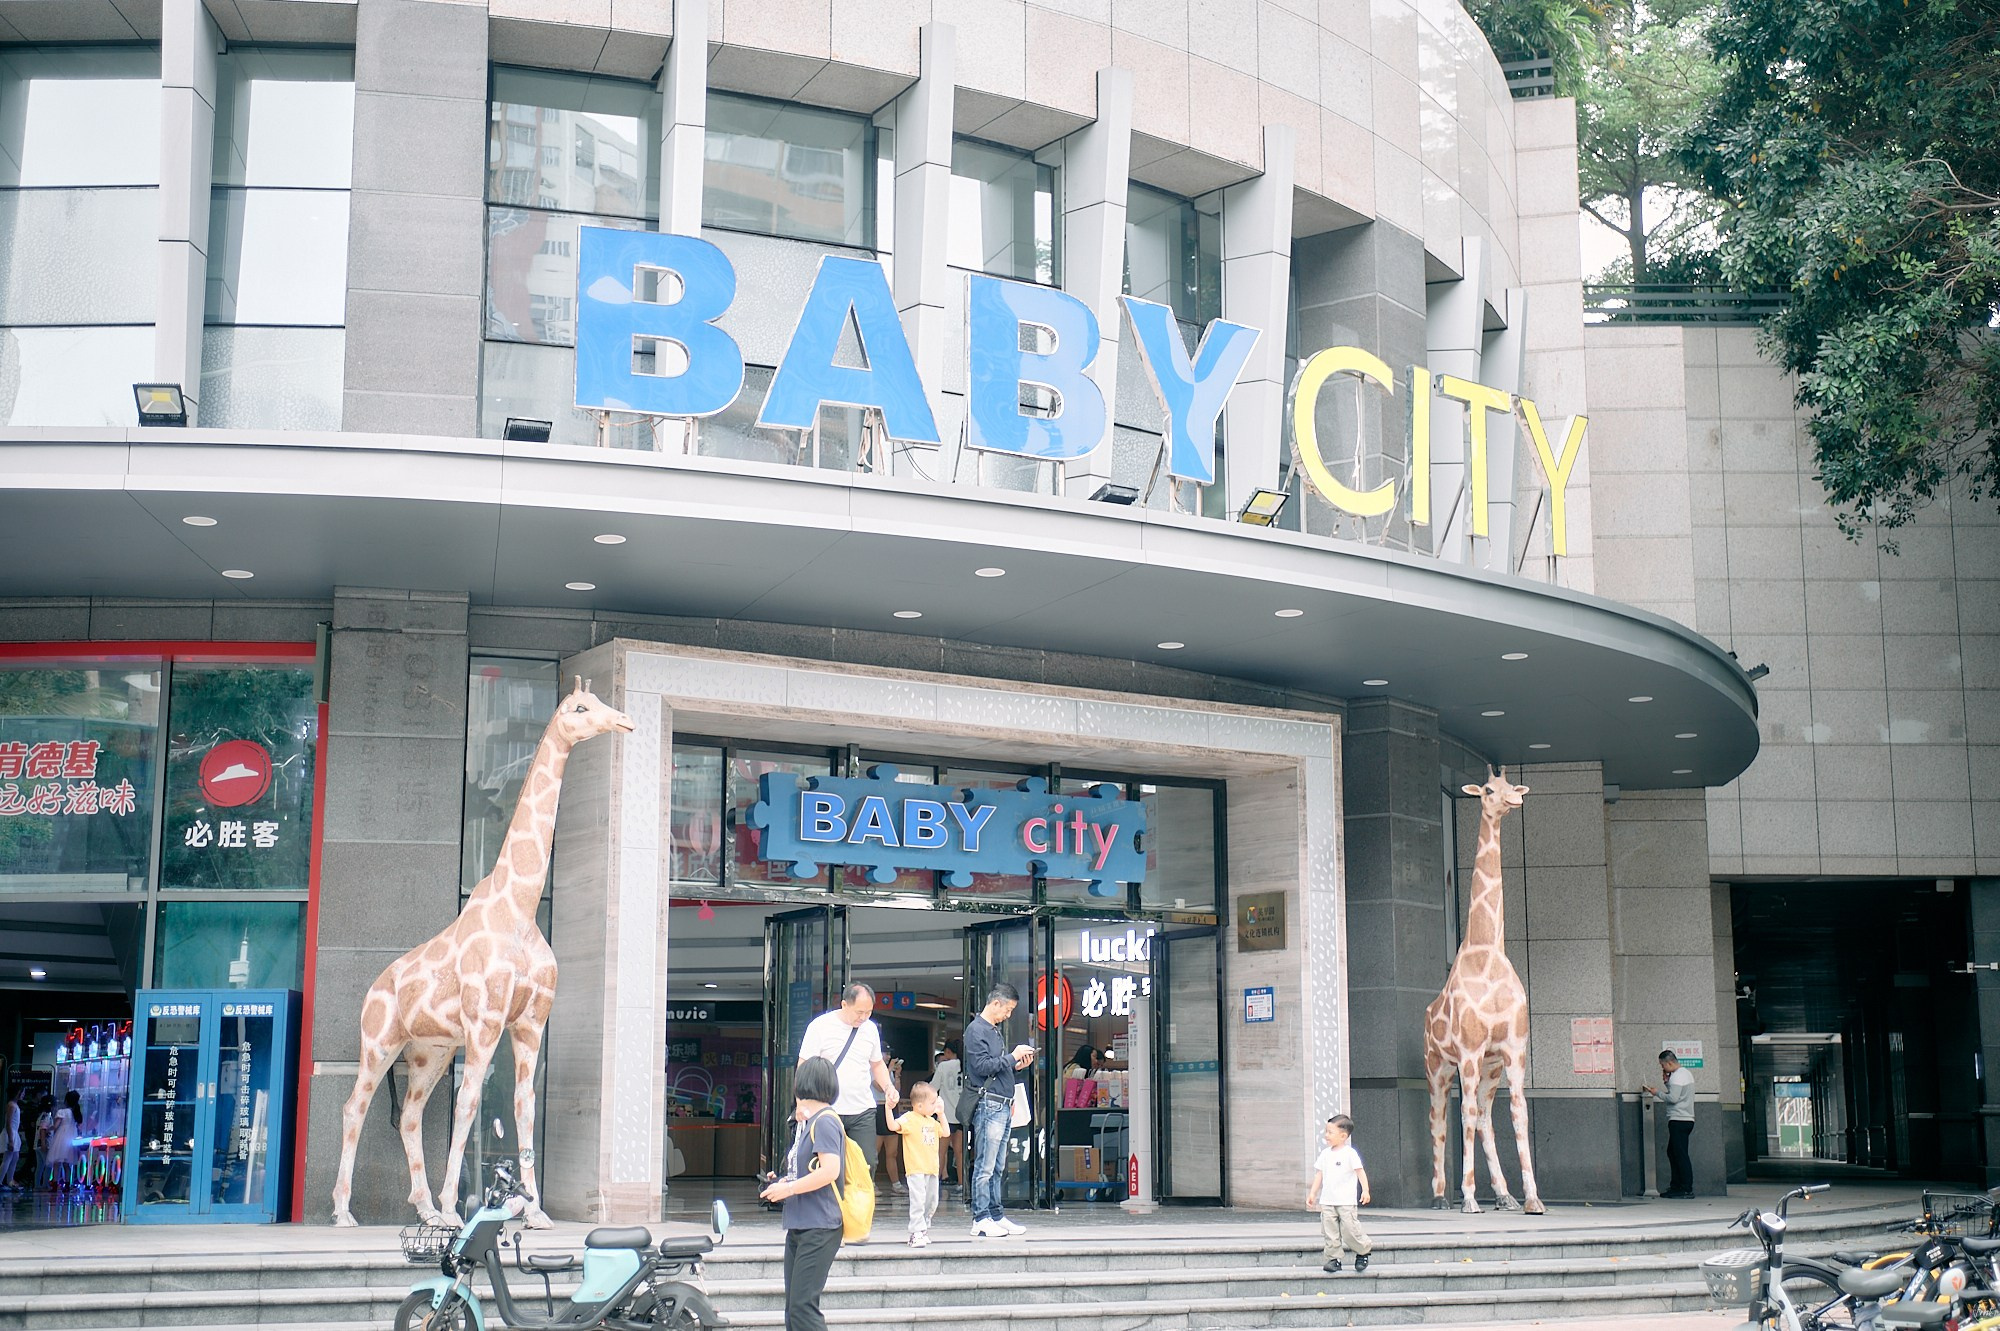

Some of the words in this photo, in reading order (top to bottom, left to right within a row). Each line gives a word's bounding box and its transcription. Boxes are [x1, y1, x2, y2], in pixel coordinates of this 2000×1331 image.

[575, 225, 1260, 486] BABY
[1290, 346, 1589, 559] CITY
[0, 740, 101, 779] 肯德基
[184, 819, 280, 848] 必胜客
[799, 789, 998, 852] BABY
[1022, 804, 1120, 871] city
[162, 1004, 201, 1016] 反恐警械库
[235, 1004, 274, 1016] 反恐警械库
[668, 1043, 698, 1057] 乐城
[162, 1045, 179, 1165] 危急时可击碎玻璃取装备
